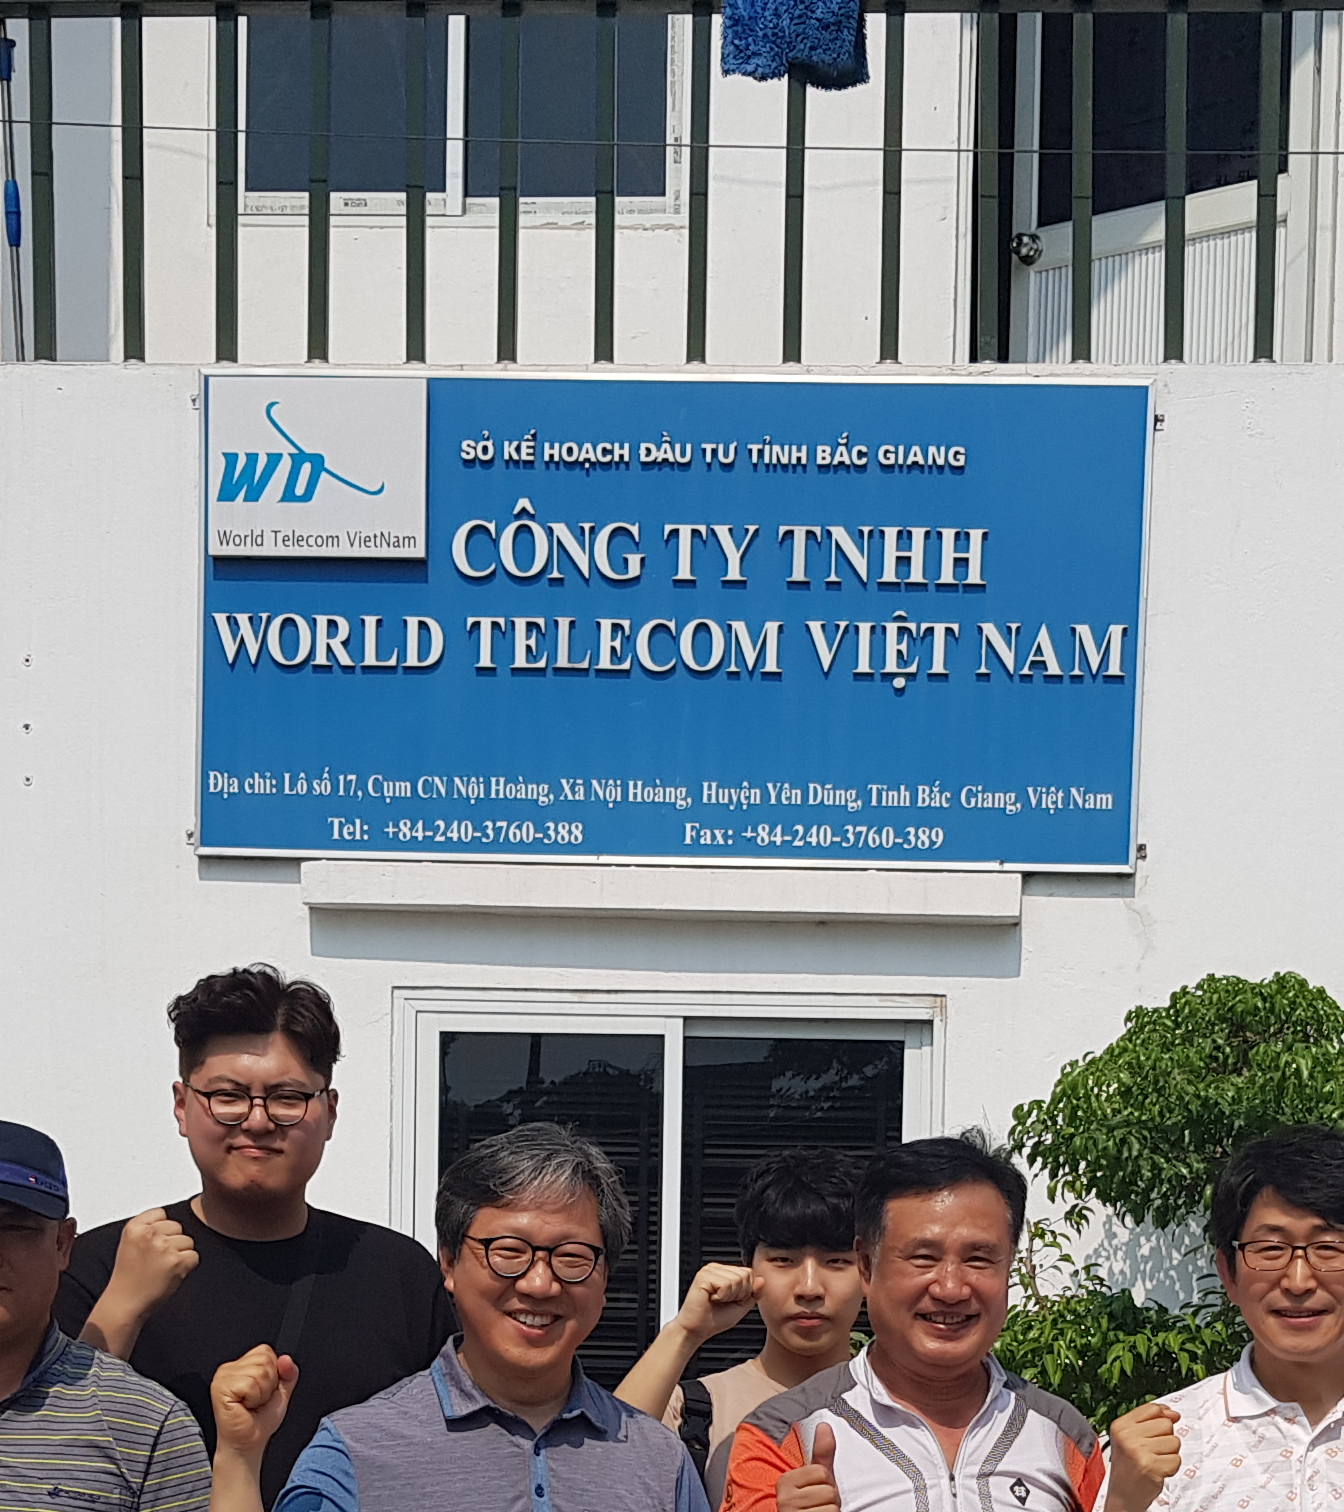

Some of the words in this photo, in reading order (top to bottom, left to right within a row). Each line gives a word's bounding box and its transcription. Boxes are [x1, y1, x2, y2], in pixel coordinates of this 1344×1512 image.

[460, 430, 494, 461] SỞ
[503, 429, 537, 461] KẾ
[543, 442, 630, 468] HOẠCH
[638, 431, 692, 463] ĐẦU
[701, 441, 738, 464] TƯ
[747, 435, 807, 465] TỈNH
[816, 431, 868, 466] BẮC
[877, 445, 966, 467] GIANG
[217, 529, 264, 548] World
[271, 529, 340, 549] Telecom
[347, 530, 417, 549] VietNam
[451, 497, 645, 580] CÔNG
[663, 524, 759, 581] TY
[778, 525, 989, 585] TNHH
[211, 612, 444, 667] WORLD
[466, 616, 783, 673] TELECOM
[805, 611, 960, 690] VIỆT
[976, 622, 1128, 676] NAM
[208, 771, 239, 799] Địa
[283, 772, 308, 795] Lô
[312, 766, 332, 796] số
[337, 774, 363, 801] 17,
[367, 774, 412, 804] Cụm
[417, 775, 447, 798] CN
[453, 776, 485, 805] Nội
[490, 776, 554, 806] Hoàng,
[559, 778, 585, 801] Xã
[590, 779, 622, 809] Nội
[627, 780, 692, 810] Hoàng,
[702, 781, 761, 812] Huyện
[766, 781, 802, 806] Yên
[808, 782, 863, 813] Dũng,
[916, 780, 951, 808] Bắc
[960, 785, 1022, 815] Giang,
[1026, 786, 1065, 815] Việt
[1069, 787, 1113, 810] Nam
[327, 817, 369, 841] Tel:
[383, 819, 583, 845] +84-240-3760-388
[683, 822, 734, 846] Fax:
[741, 823, 944, 850] +84-240-3760-389
